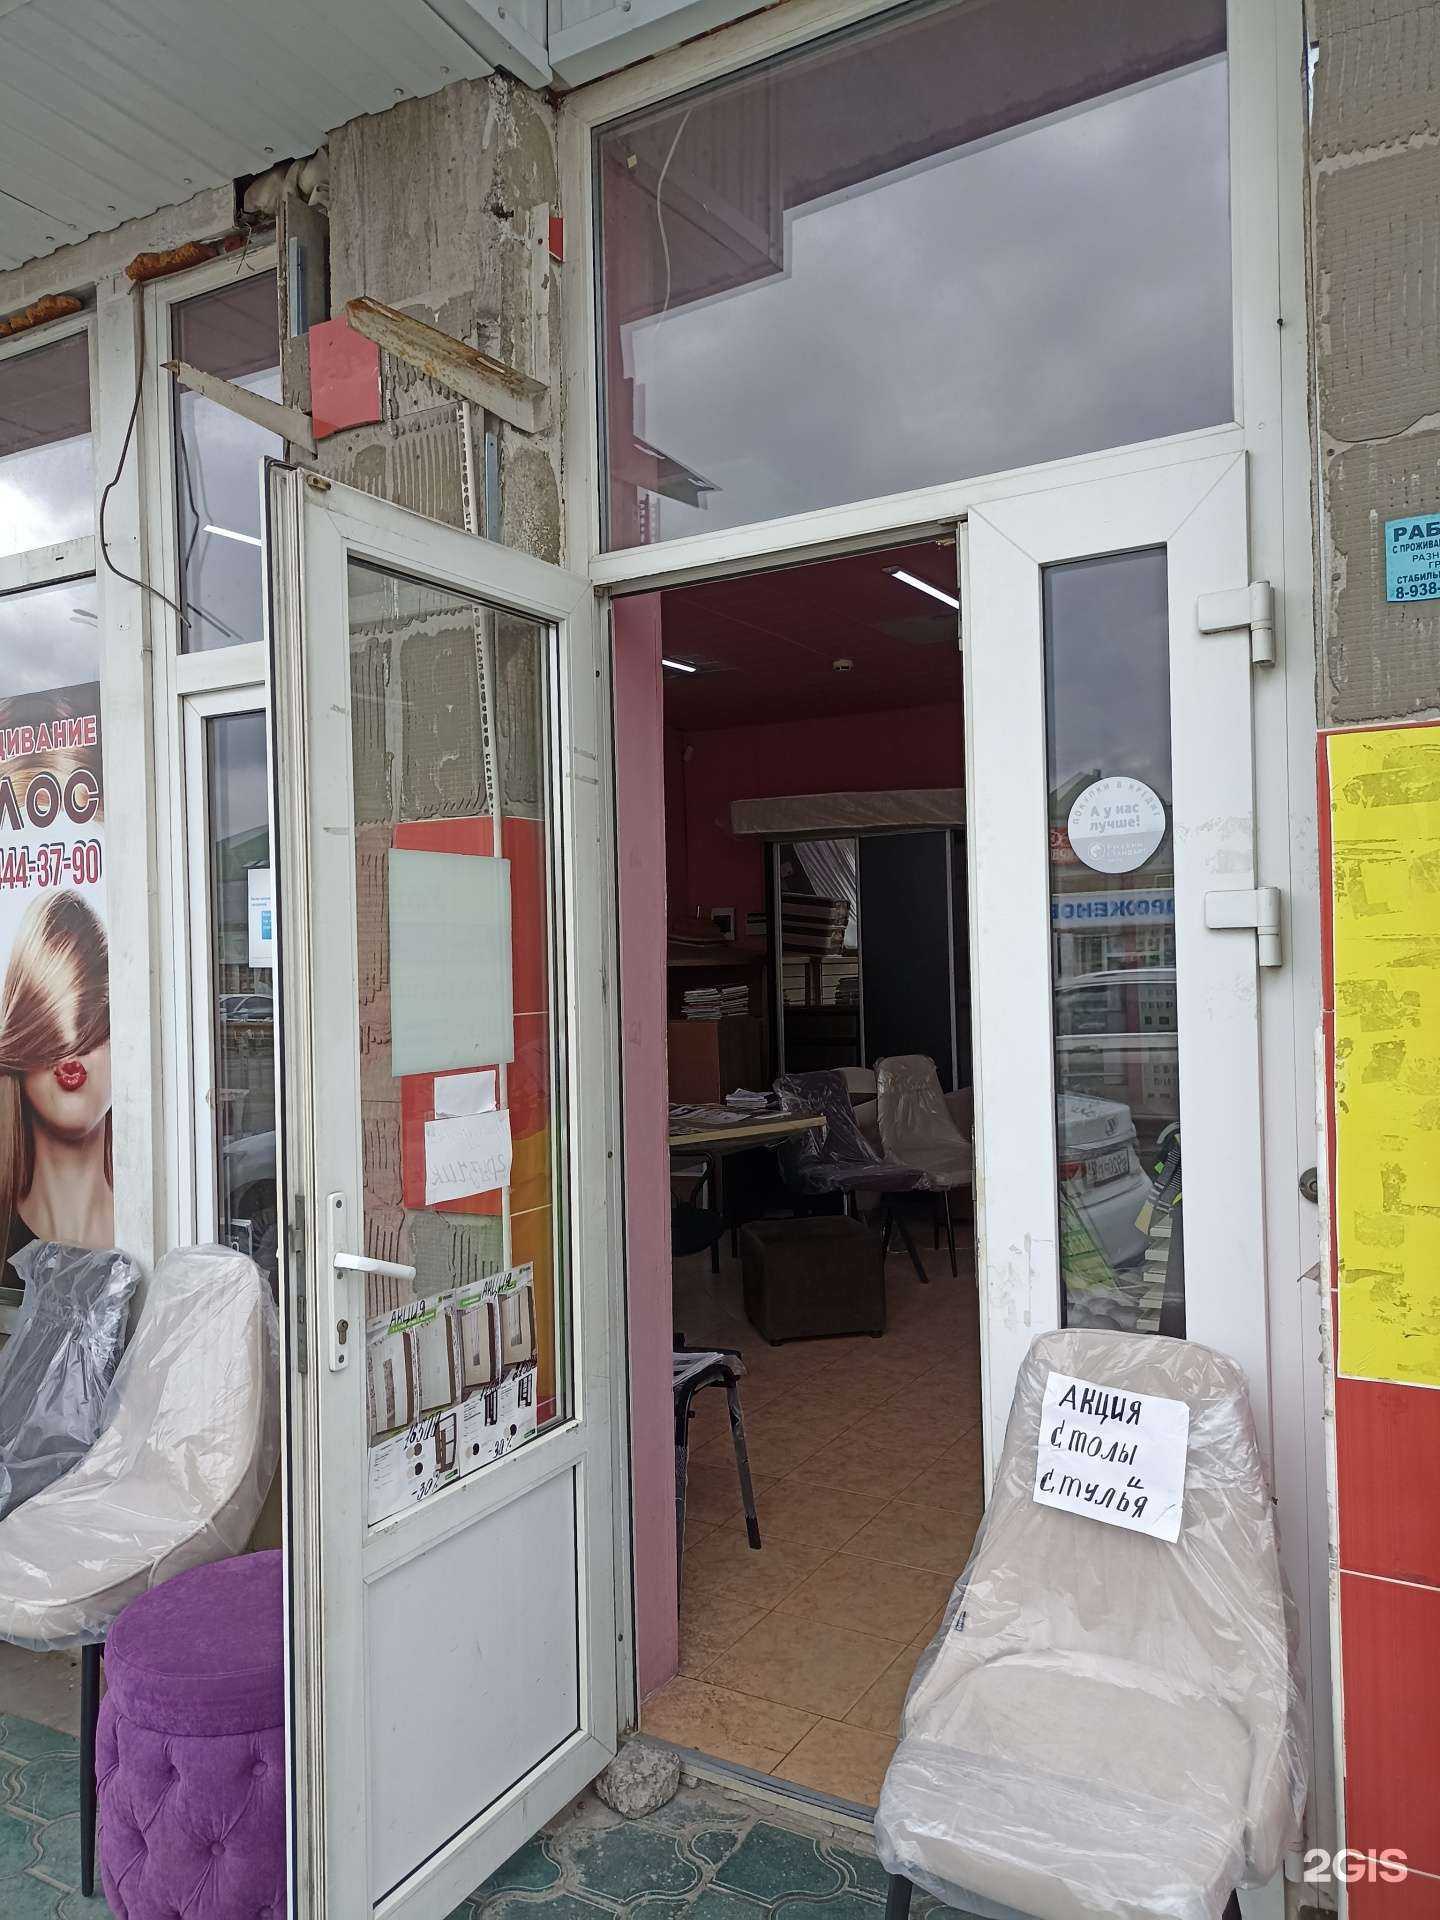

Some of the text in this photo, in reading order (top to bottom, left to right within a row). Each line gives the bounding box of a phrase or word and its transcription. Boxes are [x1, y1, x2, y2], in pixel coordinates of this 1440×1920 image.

[1400, 539, 1440, 553] ПРОЖИВА
[1397, 571, 1440, 584] СТАБИЛЬ
[1090, 803, 1139, 819] А у нас
[1089, 815, 1140, 833] лучше!
[389, 1299, 426, 1327] АКЦИЯ
[1059, 1384, 1142, 1425] АКЦИЯ
